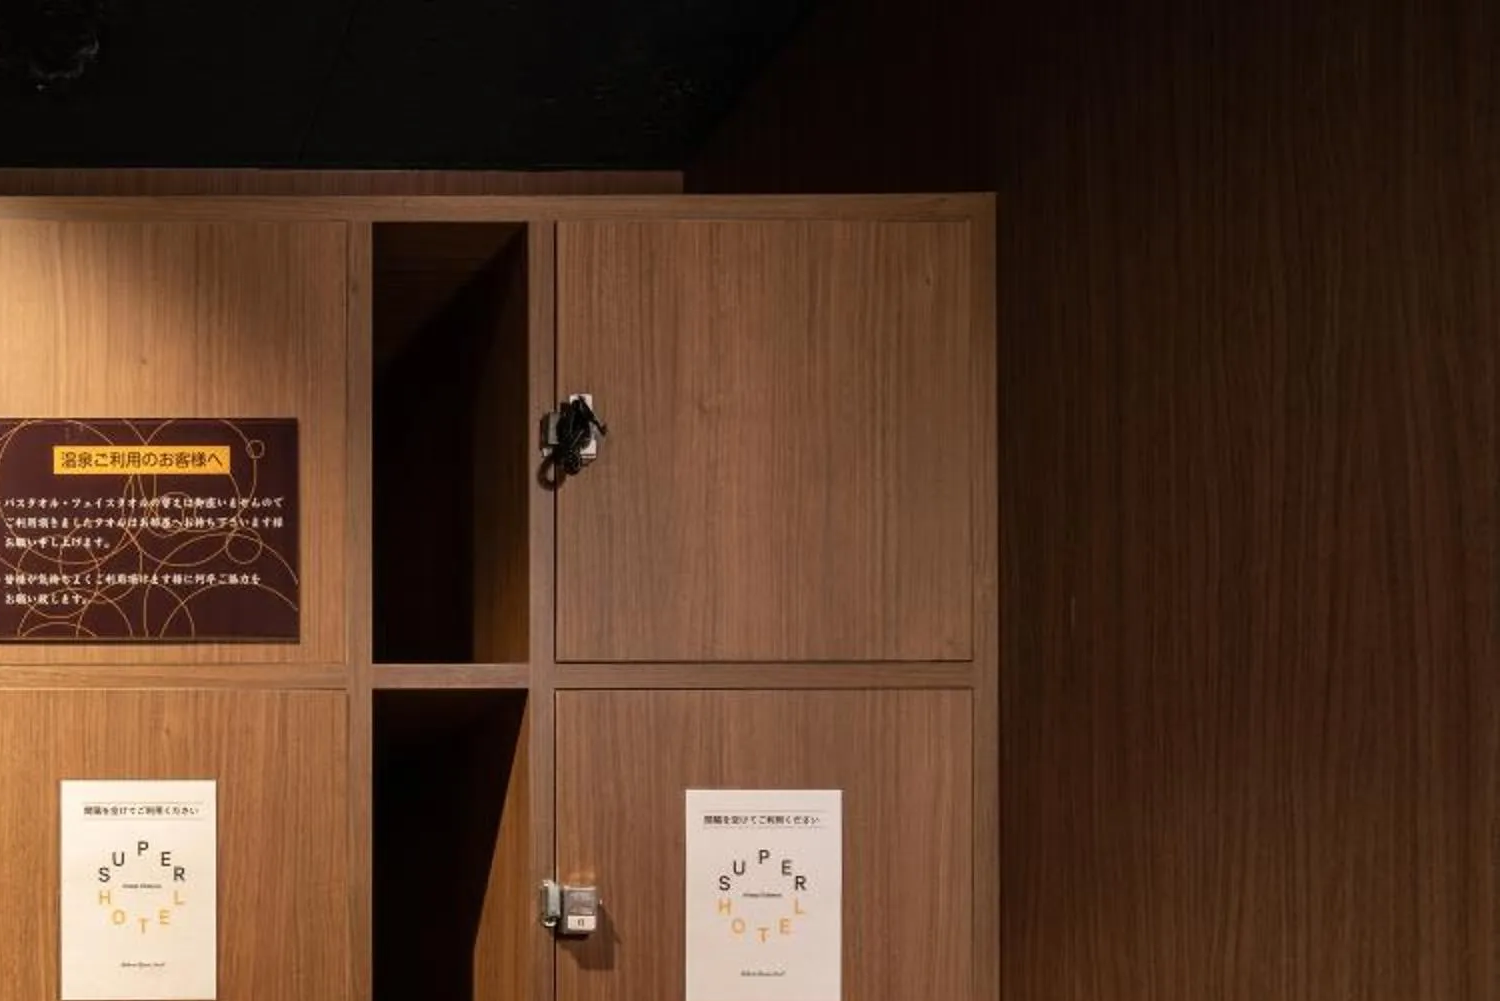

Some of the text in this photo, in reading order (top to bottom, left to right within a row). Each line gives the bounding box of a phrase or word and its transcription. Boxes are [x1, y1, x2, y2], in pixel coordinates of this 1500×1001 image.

[60, 451, 224, 469] 温泉ご利用のお客様へ
[97, 840, 186, 883] SUPER
[718, 849, 807, 891] SUPER
[98, 890, 185, 934] HOTEL
[718, 899, 806, 943] HOTEL
